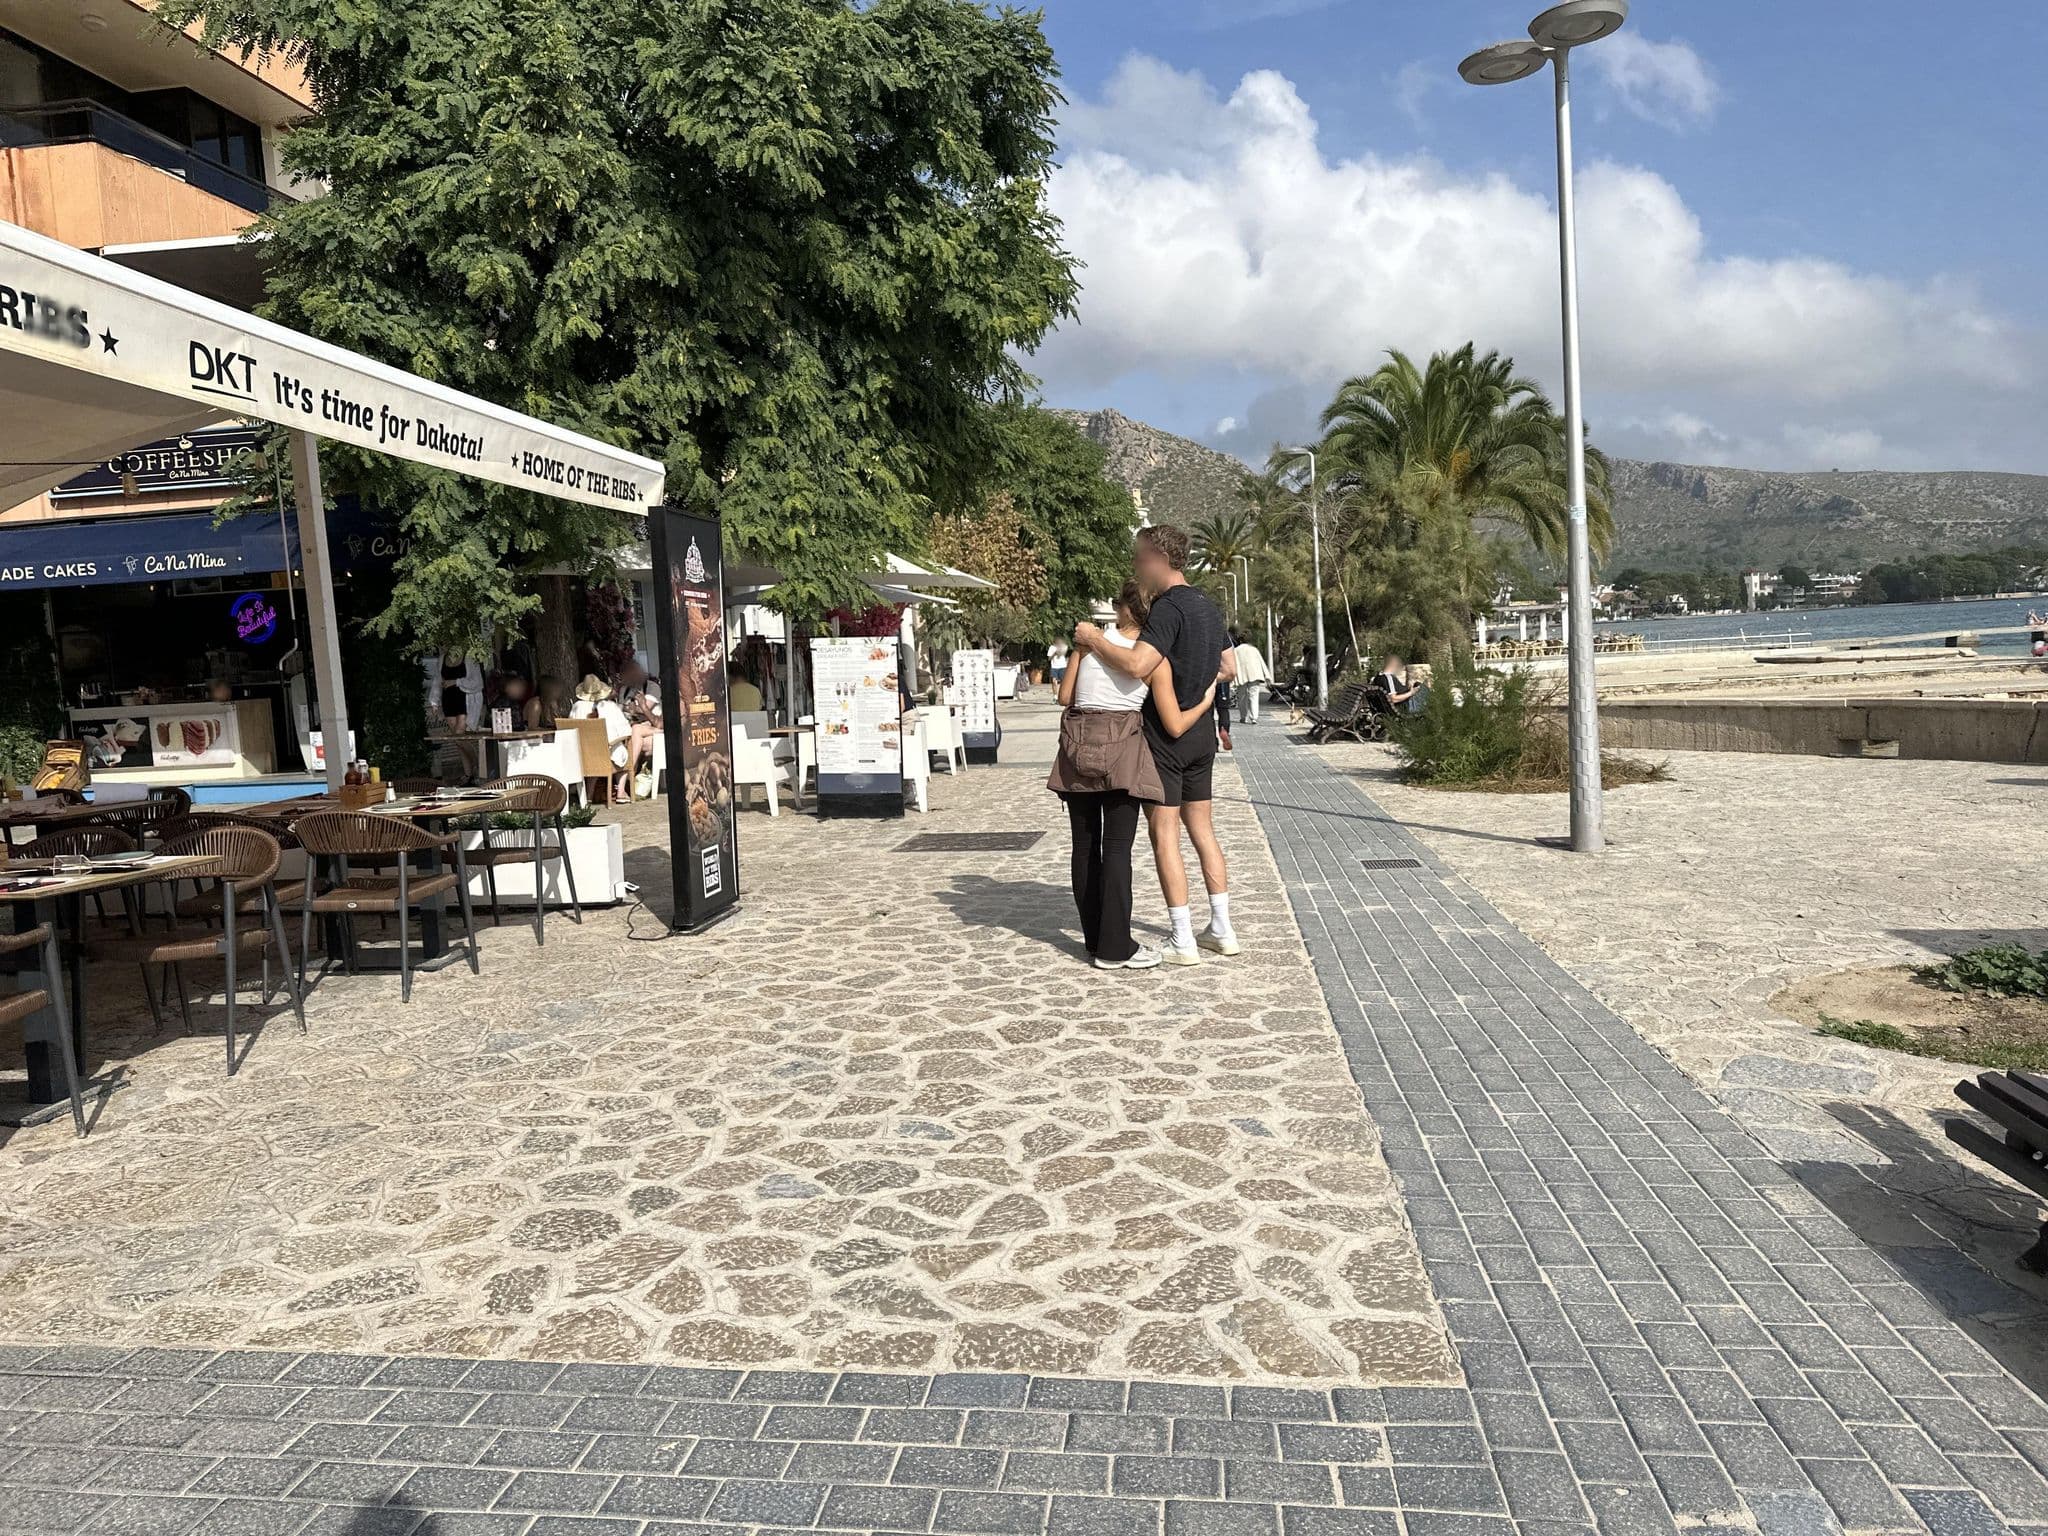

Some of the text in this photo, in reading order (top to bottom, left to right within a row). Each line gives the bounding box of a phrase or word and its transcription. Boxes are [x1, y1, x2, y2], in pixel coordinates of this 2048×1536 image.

[190, 340, 257, 393] DKT
[273, 372, 484, 462] It's time for Dakota!
[108, 446, 253, 473] COFFEESHO
[522, 451, 636, 502] HOME OF THE RIBS
[43, 562, 97, 578] CAKES
[691, 727, 717, 747] FRIES
